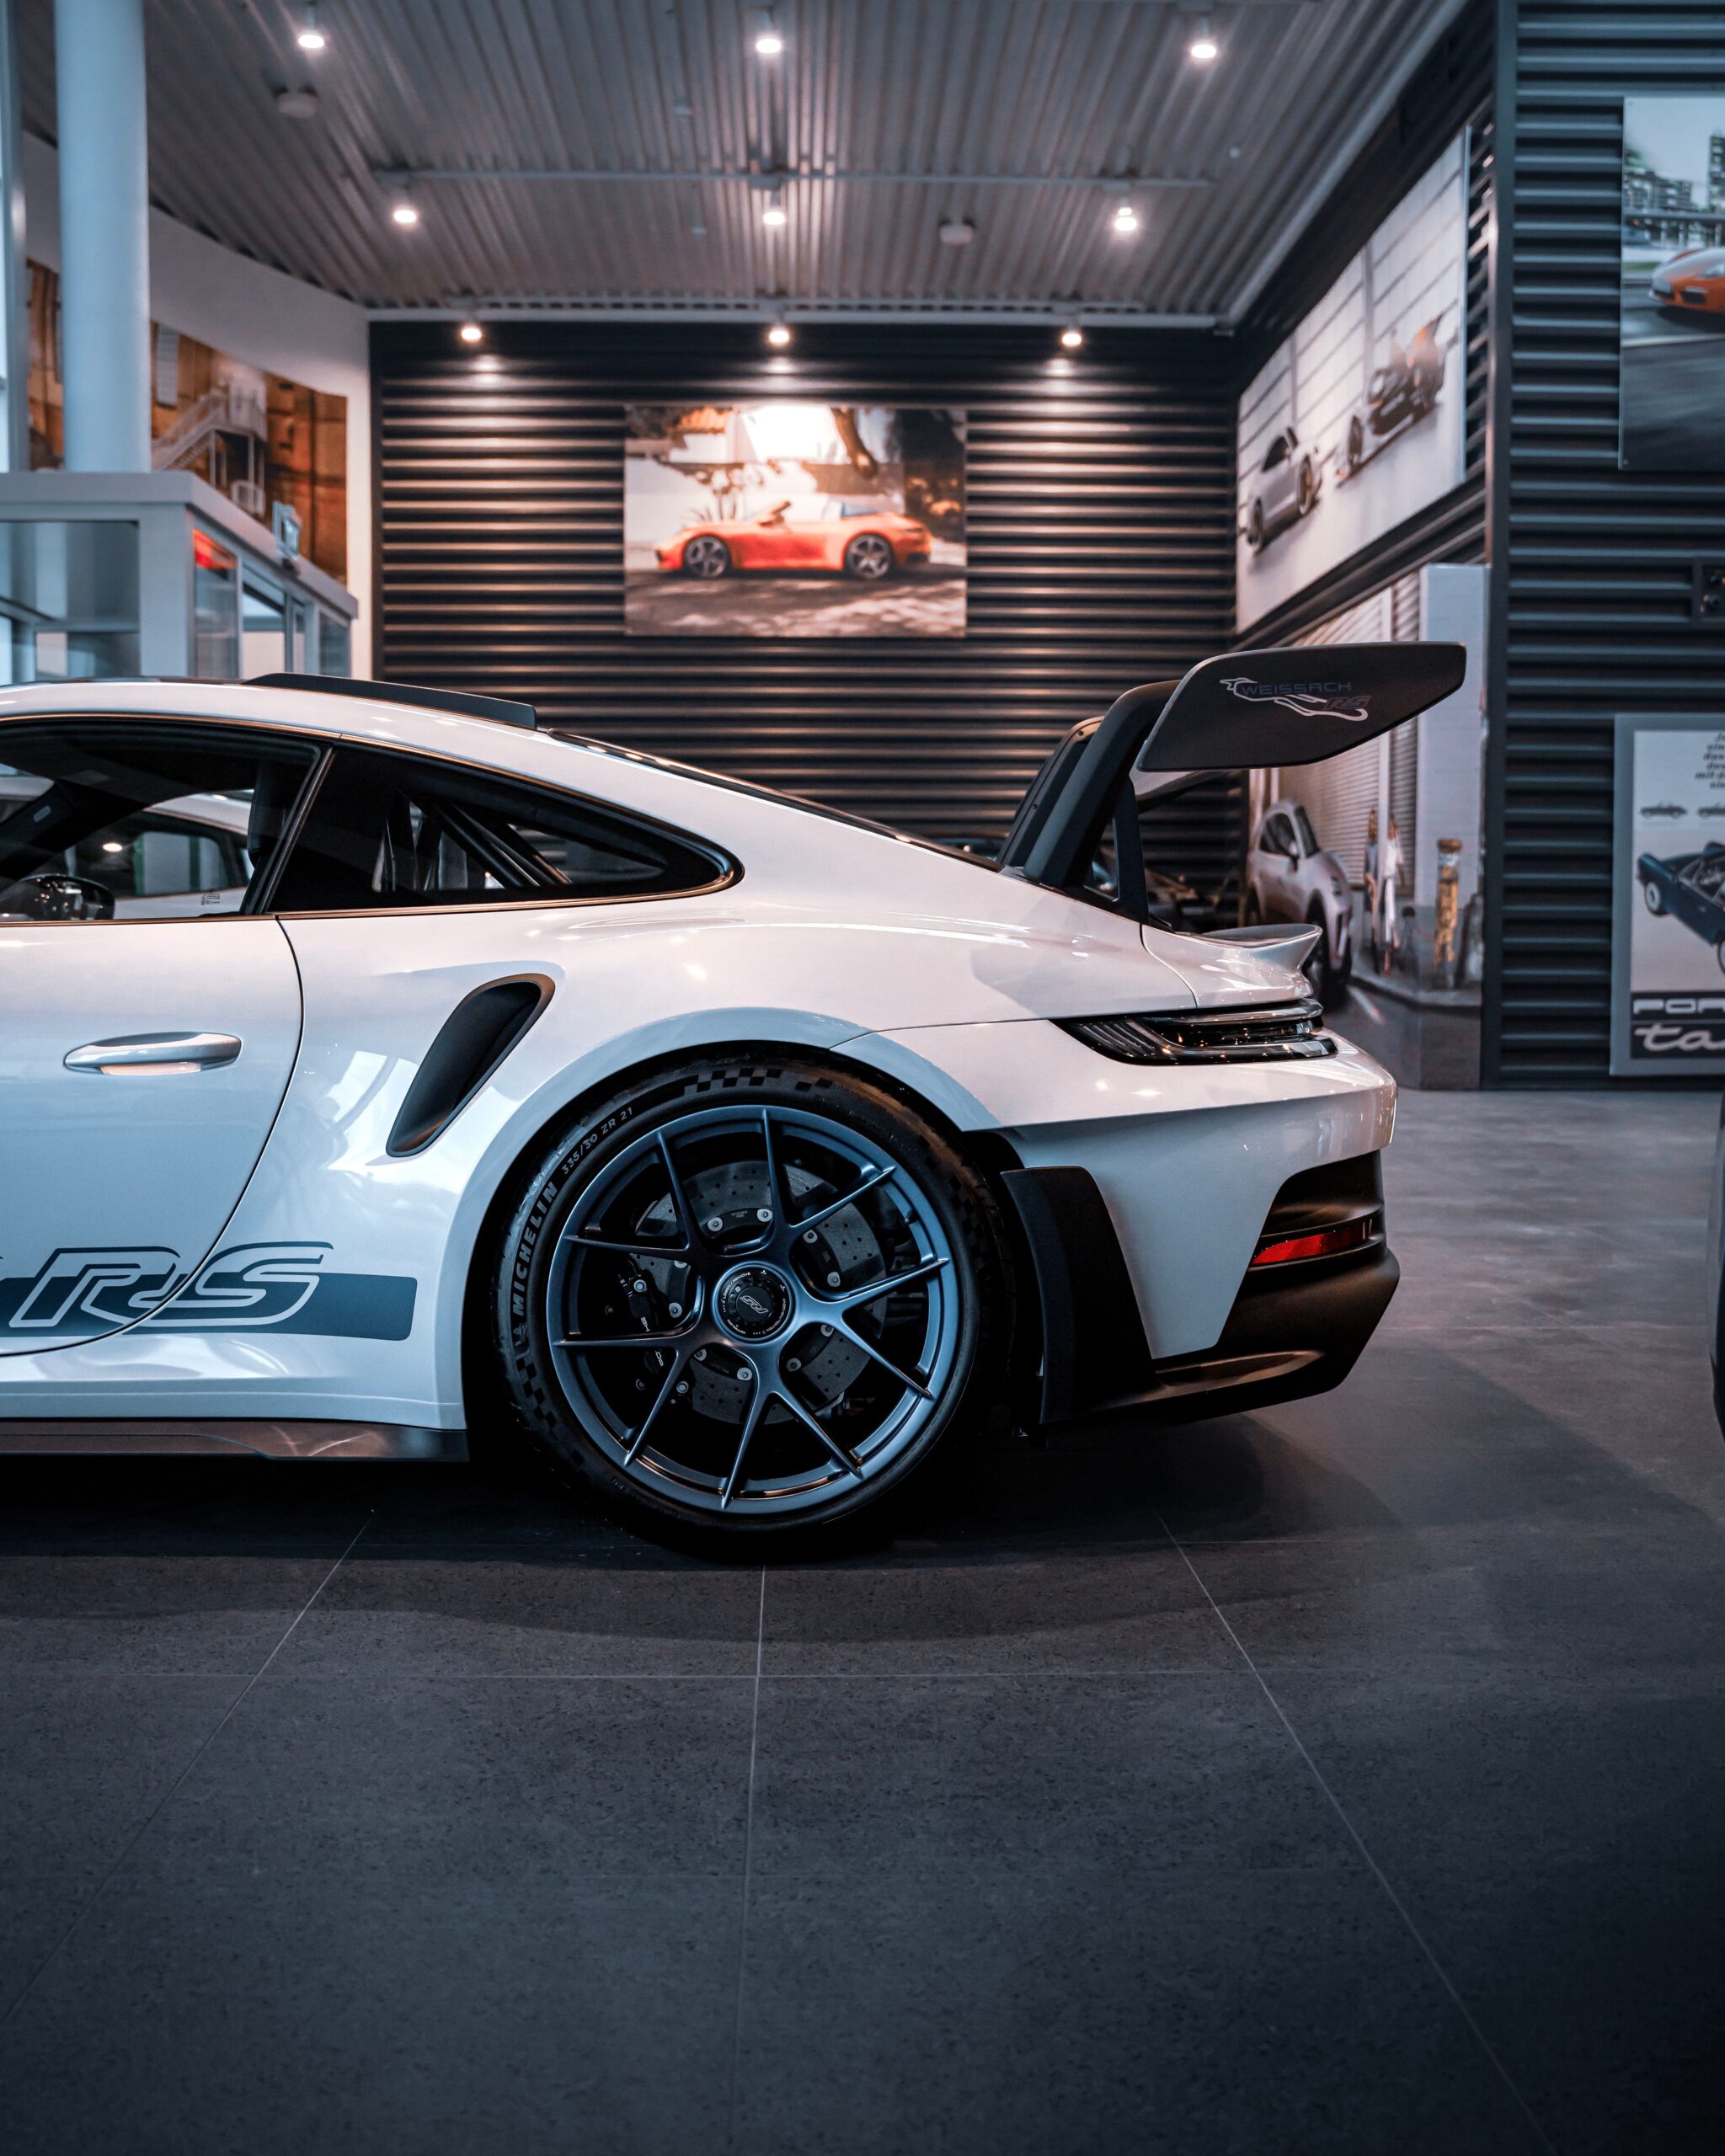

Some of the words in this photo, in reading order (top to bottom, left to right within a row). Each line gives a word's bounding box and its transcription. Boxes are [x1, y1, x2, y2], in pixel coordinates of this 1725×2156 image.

[1241, 681, 1352, 696] WEISSACH
[1322, 695, 1371, 711] RS
[562, 1133, 598, 1175] 335/30
[601, 1118, 617, 1135] ZR
[620, 1106, 633, 1121] 21
[512, 1181, 558, 1316] MICHELIN
[8, 1241, 334, 1328] RS
